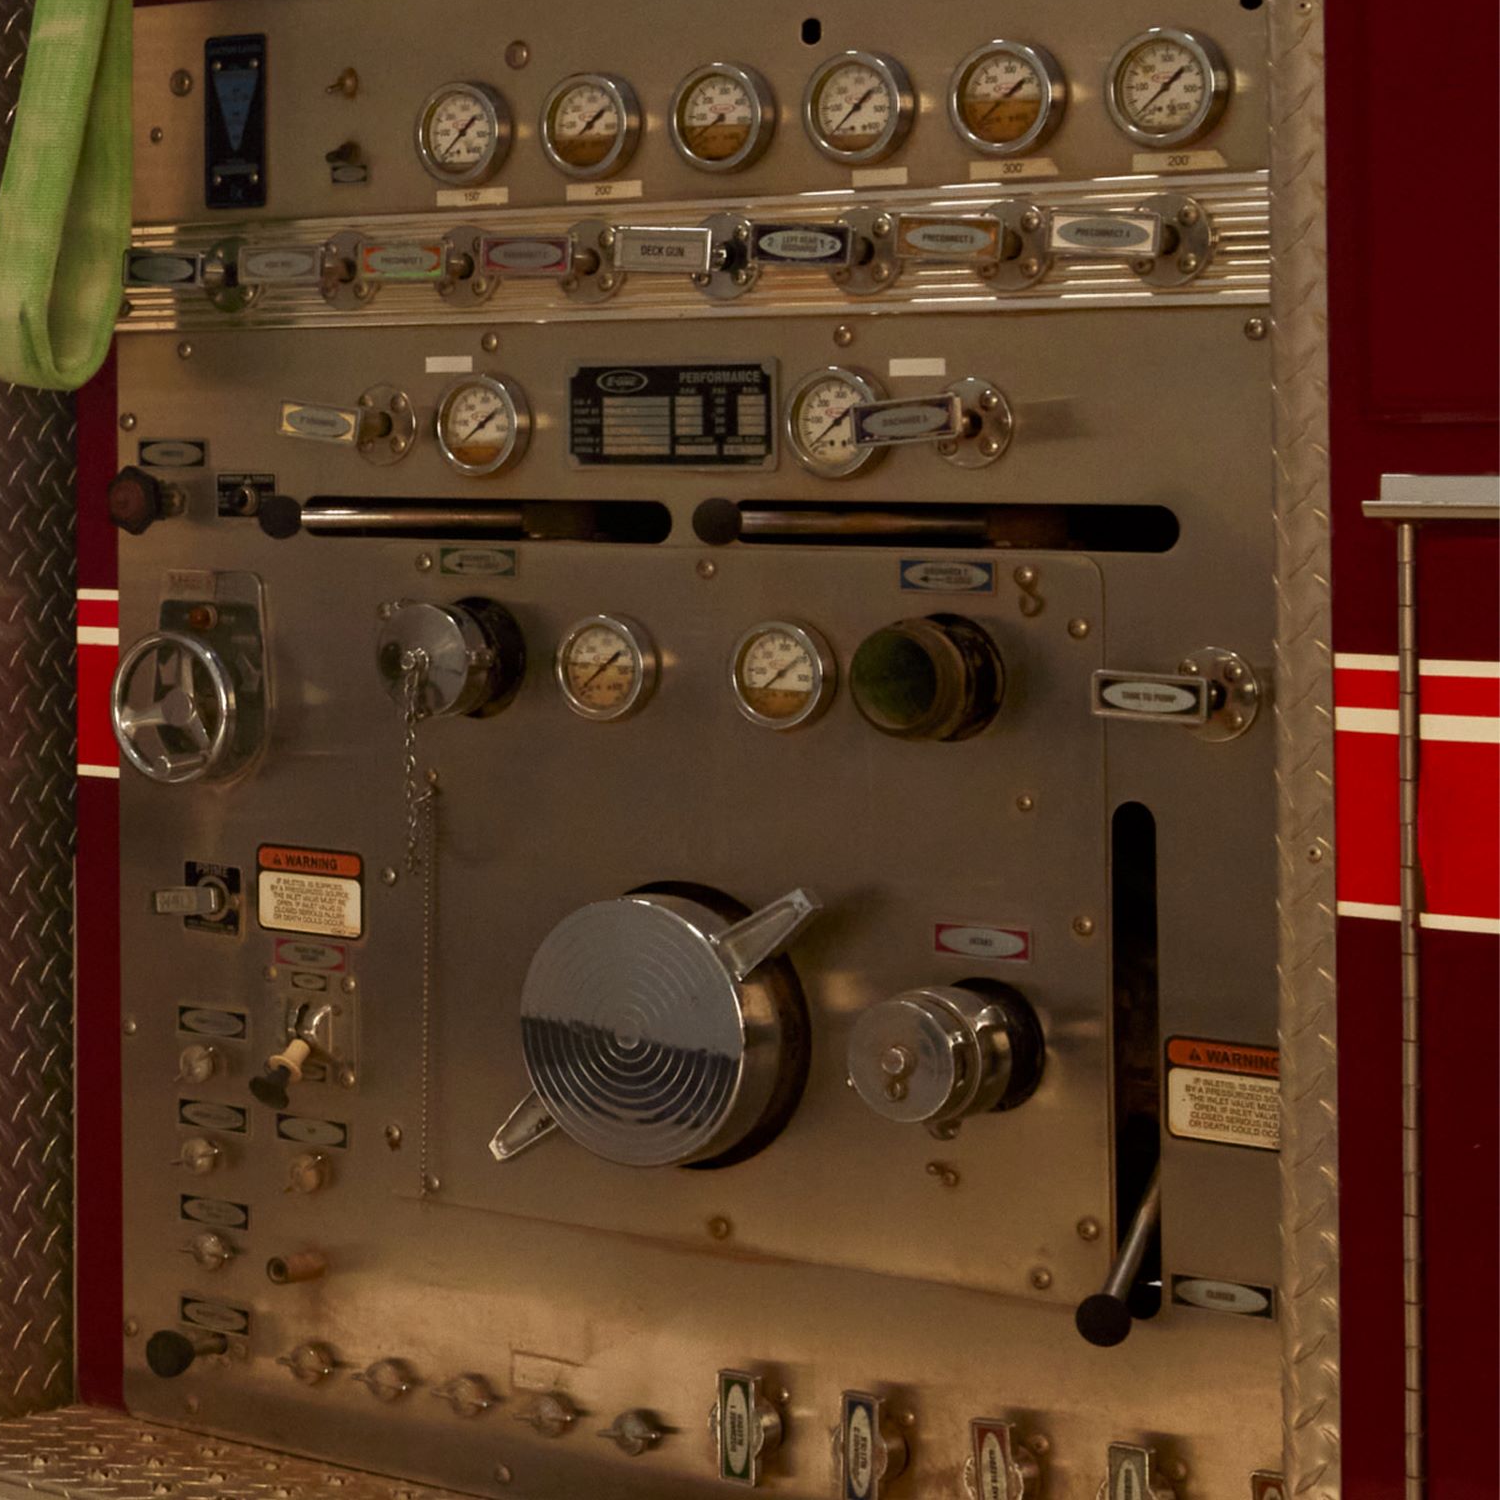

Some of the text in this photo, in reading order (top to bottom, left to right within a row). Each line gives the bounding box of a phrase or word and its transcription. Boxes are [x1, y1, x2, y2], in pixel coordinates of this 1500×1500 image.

[922, 233, 968, 244] PRECONNECT
[1075, 228, 1124, 238] PRECONNECT
[641, 245, 685, 257] DECK GUN
[679, 371, 761, 384] PERFORMANCE
[285, 854, 338, 870] WARNING
[1190, 1111, 1224, 1122] CLOSED
[1188, 1119, 1201, 1128] OR
[1203, 1121, 1230, 1132] DEATH
[1231, 1125, 1260, 1136] COULD
